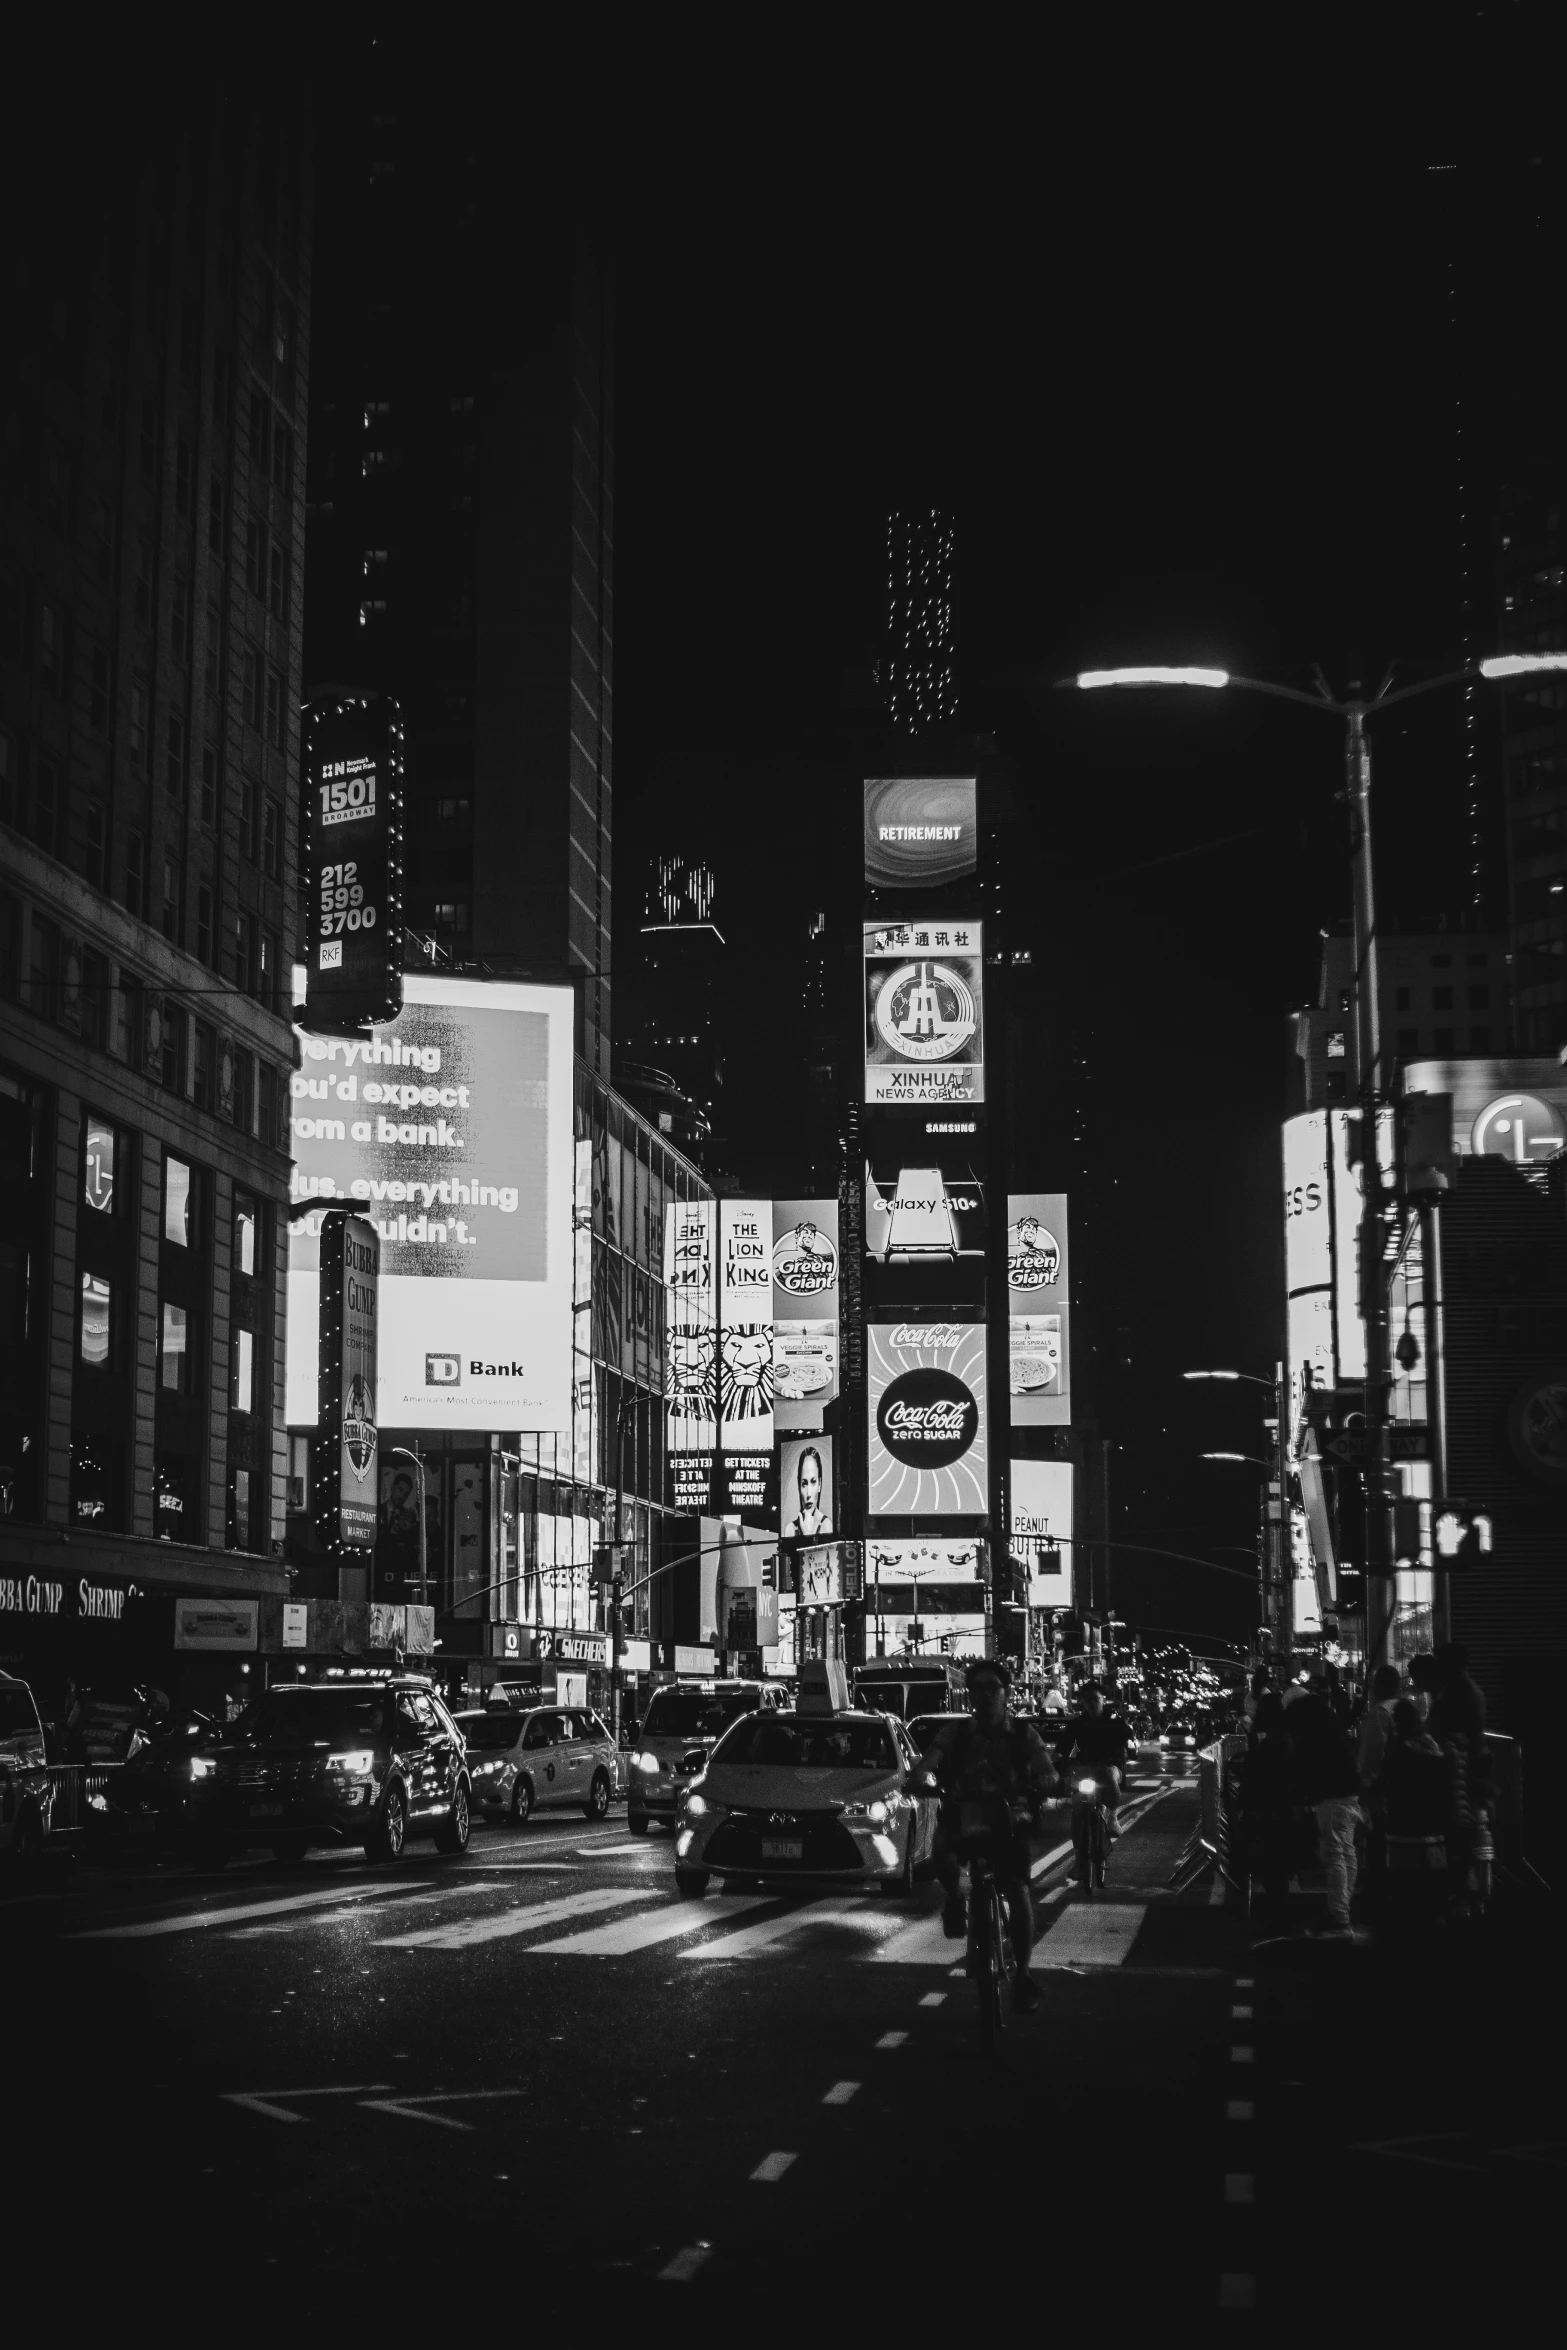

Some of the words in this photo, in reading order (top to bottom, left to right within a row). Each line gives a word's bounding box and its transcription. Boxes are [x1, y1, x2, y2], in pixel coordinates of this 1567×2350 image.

[319, 775, 376, 812] 1501
[324, 806, 374, 822] BROADWAY
[879, 826, 961, 841] RETIREMENT
[320, 862, 357, 889] 212
[321, 885, 363, 912] 599
[320, 906, 376, 936] 3700
[321, 947, 340, 961] RKF
[898, 1040, 955, 1057] XINHUA
[891, 1072, 955, 1087] XINHUA
[363, 1082, 470, 1110] expect
[876, 1088, 915, 1099] NEWS
[351, 1121, 372, 1142] a
[378, 1116, 464, 1148] bank.
[925, 1122, 976, 1133] SAMSUNG
[350, 1178, 519, 1213] everything
[873, 1198, 936, 1214] Galaxy
[942, 1197, 978, 1211] S10+
[733, 1223, 758, 1236] THE
[345, 1232, 377, 1277] BUBBA
[728, 1239, 764, 1260] LION
[726, 1262, 769, 1287] KING
[779, 1258, 832, 1274] Green
[785, 1273, 836, 1289] Giant
[1008, 1270, 1059, 1285] Giant
[348, 1276, 375, 1316] GUMP
[350, 1323, 373, 1337] SHRIMP
[889, 1323, 963, 1348] Coca-Cola
[428, 1358, 458, 1381] TD
[470, 1360, 524, 1377] Bank
[403, 1396, 444, 1405] America's
[447, 1396, 468, 1405] Most
[471, 1397, 520, 1407] Convenient
[885, 1400, 970, 1429] Coca-Cola
[892, 1430, 922, 1440] zero
[923, 1429, 961, 1440] SUGAR
[724, 1458, 739, 1469] GET
[740, 1458, 770, 1469] TICKETS
[735, 1469, 744, 1480] AT
[745, 1469, 760, 1480] THE
[728, 1482, 766, 1493] MINSKOFF
[731, 1494, 764, 1506] THEATRE
[341, 1508, 377, 1524] RESTAURANT
[1014, 1516, 1049, 1533] PEANUT
[347, 1526, 371, 1539] MARKET
[846, 1543, 858, 1598] HELLO!
[26, 1574, 63, 1614] GUMP
[79, 1577, 125, 1619] SHRIMP
[758, 1591, 773, 1617] NYC
[560, 1638, 606, 1662] SKECHERS
